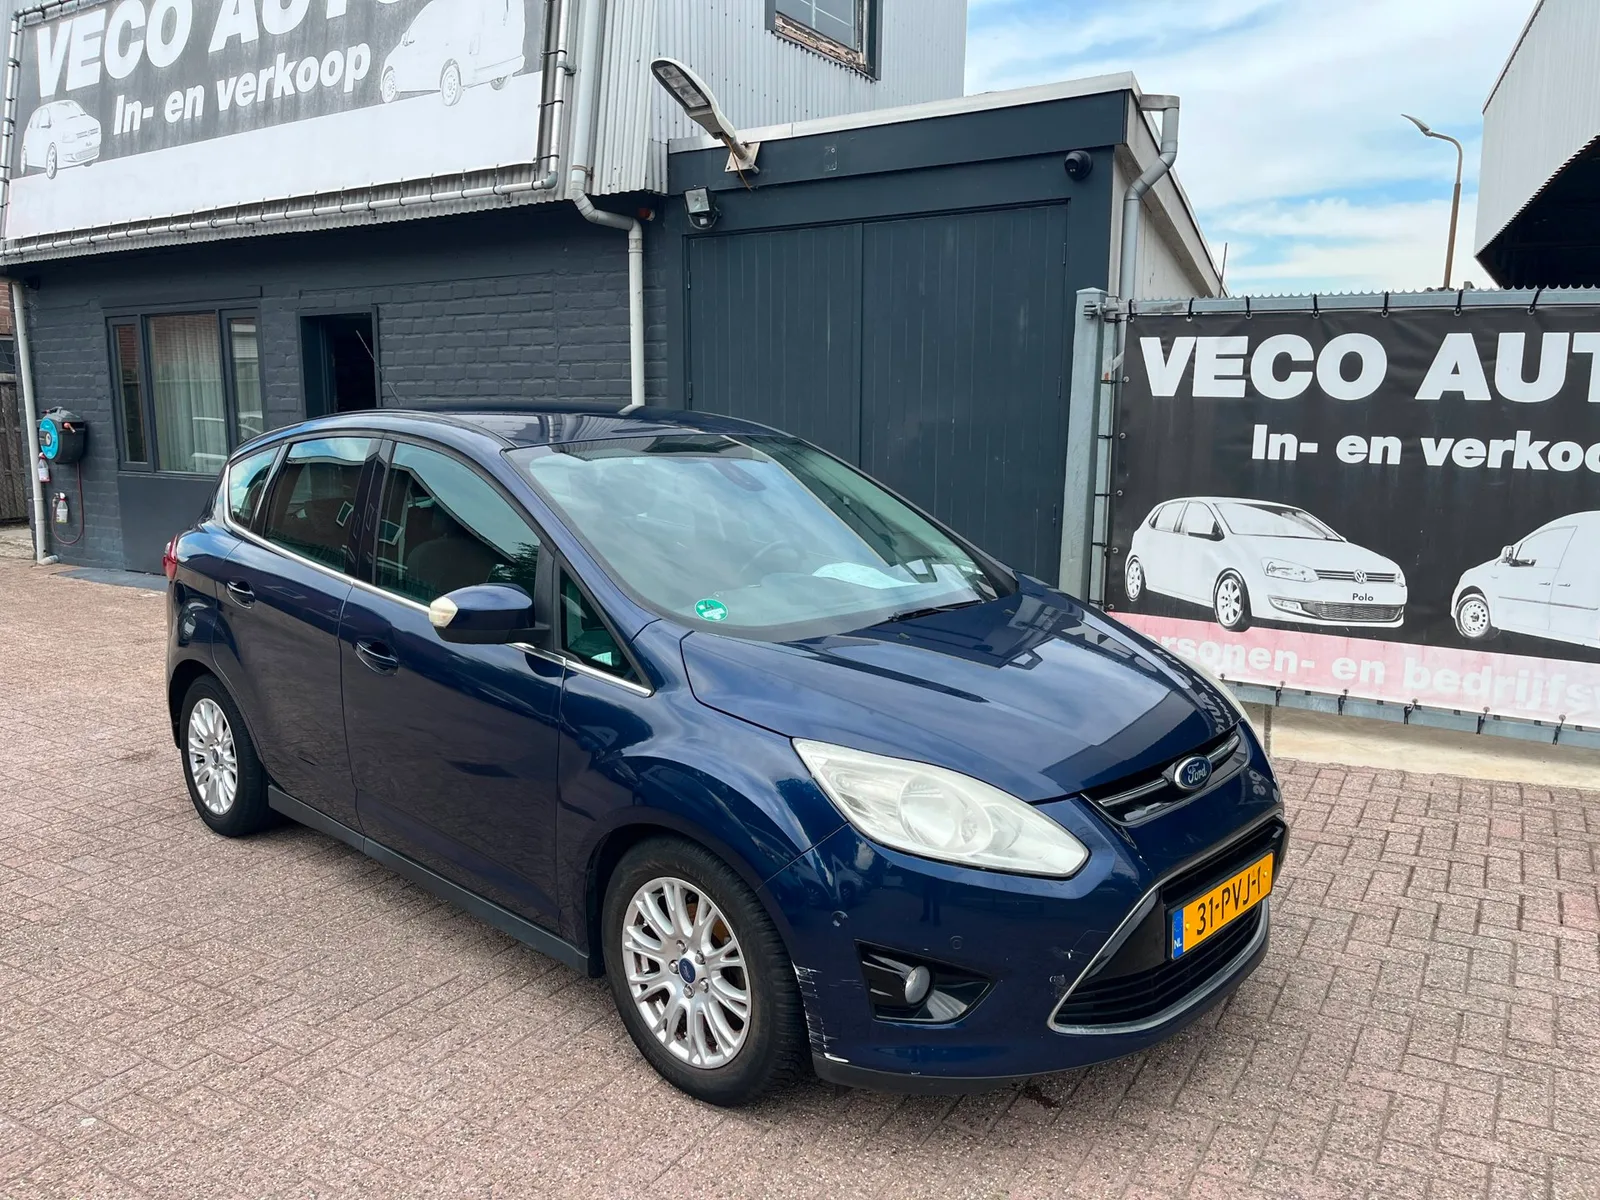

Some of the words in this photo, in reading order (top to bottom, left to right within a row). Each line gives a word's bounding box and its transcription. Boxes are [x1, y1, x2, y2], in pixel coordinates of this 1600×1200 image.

[36, 0, 193, 98] VECO
[113, 93, 154, 136] In-
[164, 82, 205, 124] en
[217, 43, 371, 110] verkoop
[1139, 332, 1388, 400] VECO
[1251, 424, 1318, 461] In-
[1336, 435, 1402, 465] en
[1352, 592, 1374, 602] Polo
[1331, 656, 1385, 685] en
[1402, 656, 1600, 714] bedrijfs
[1186, 761, 1207, 784] Ford
[1196, 866, 1261, 936] 31-PVJ-1
[1173, 937, 1183, 949] NL
